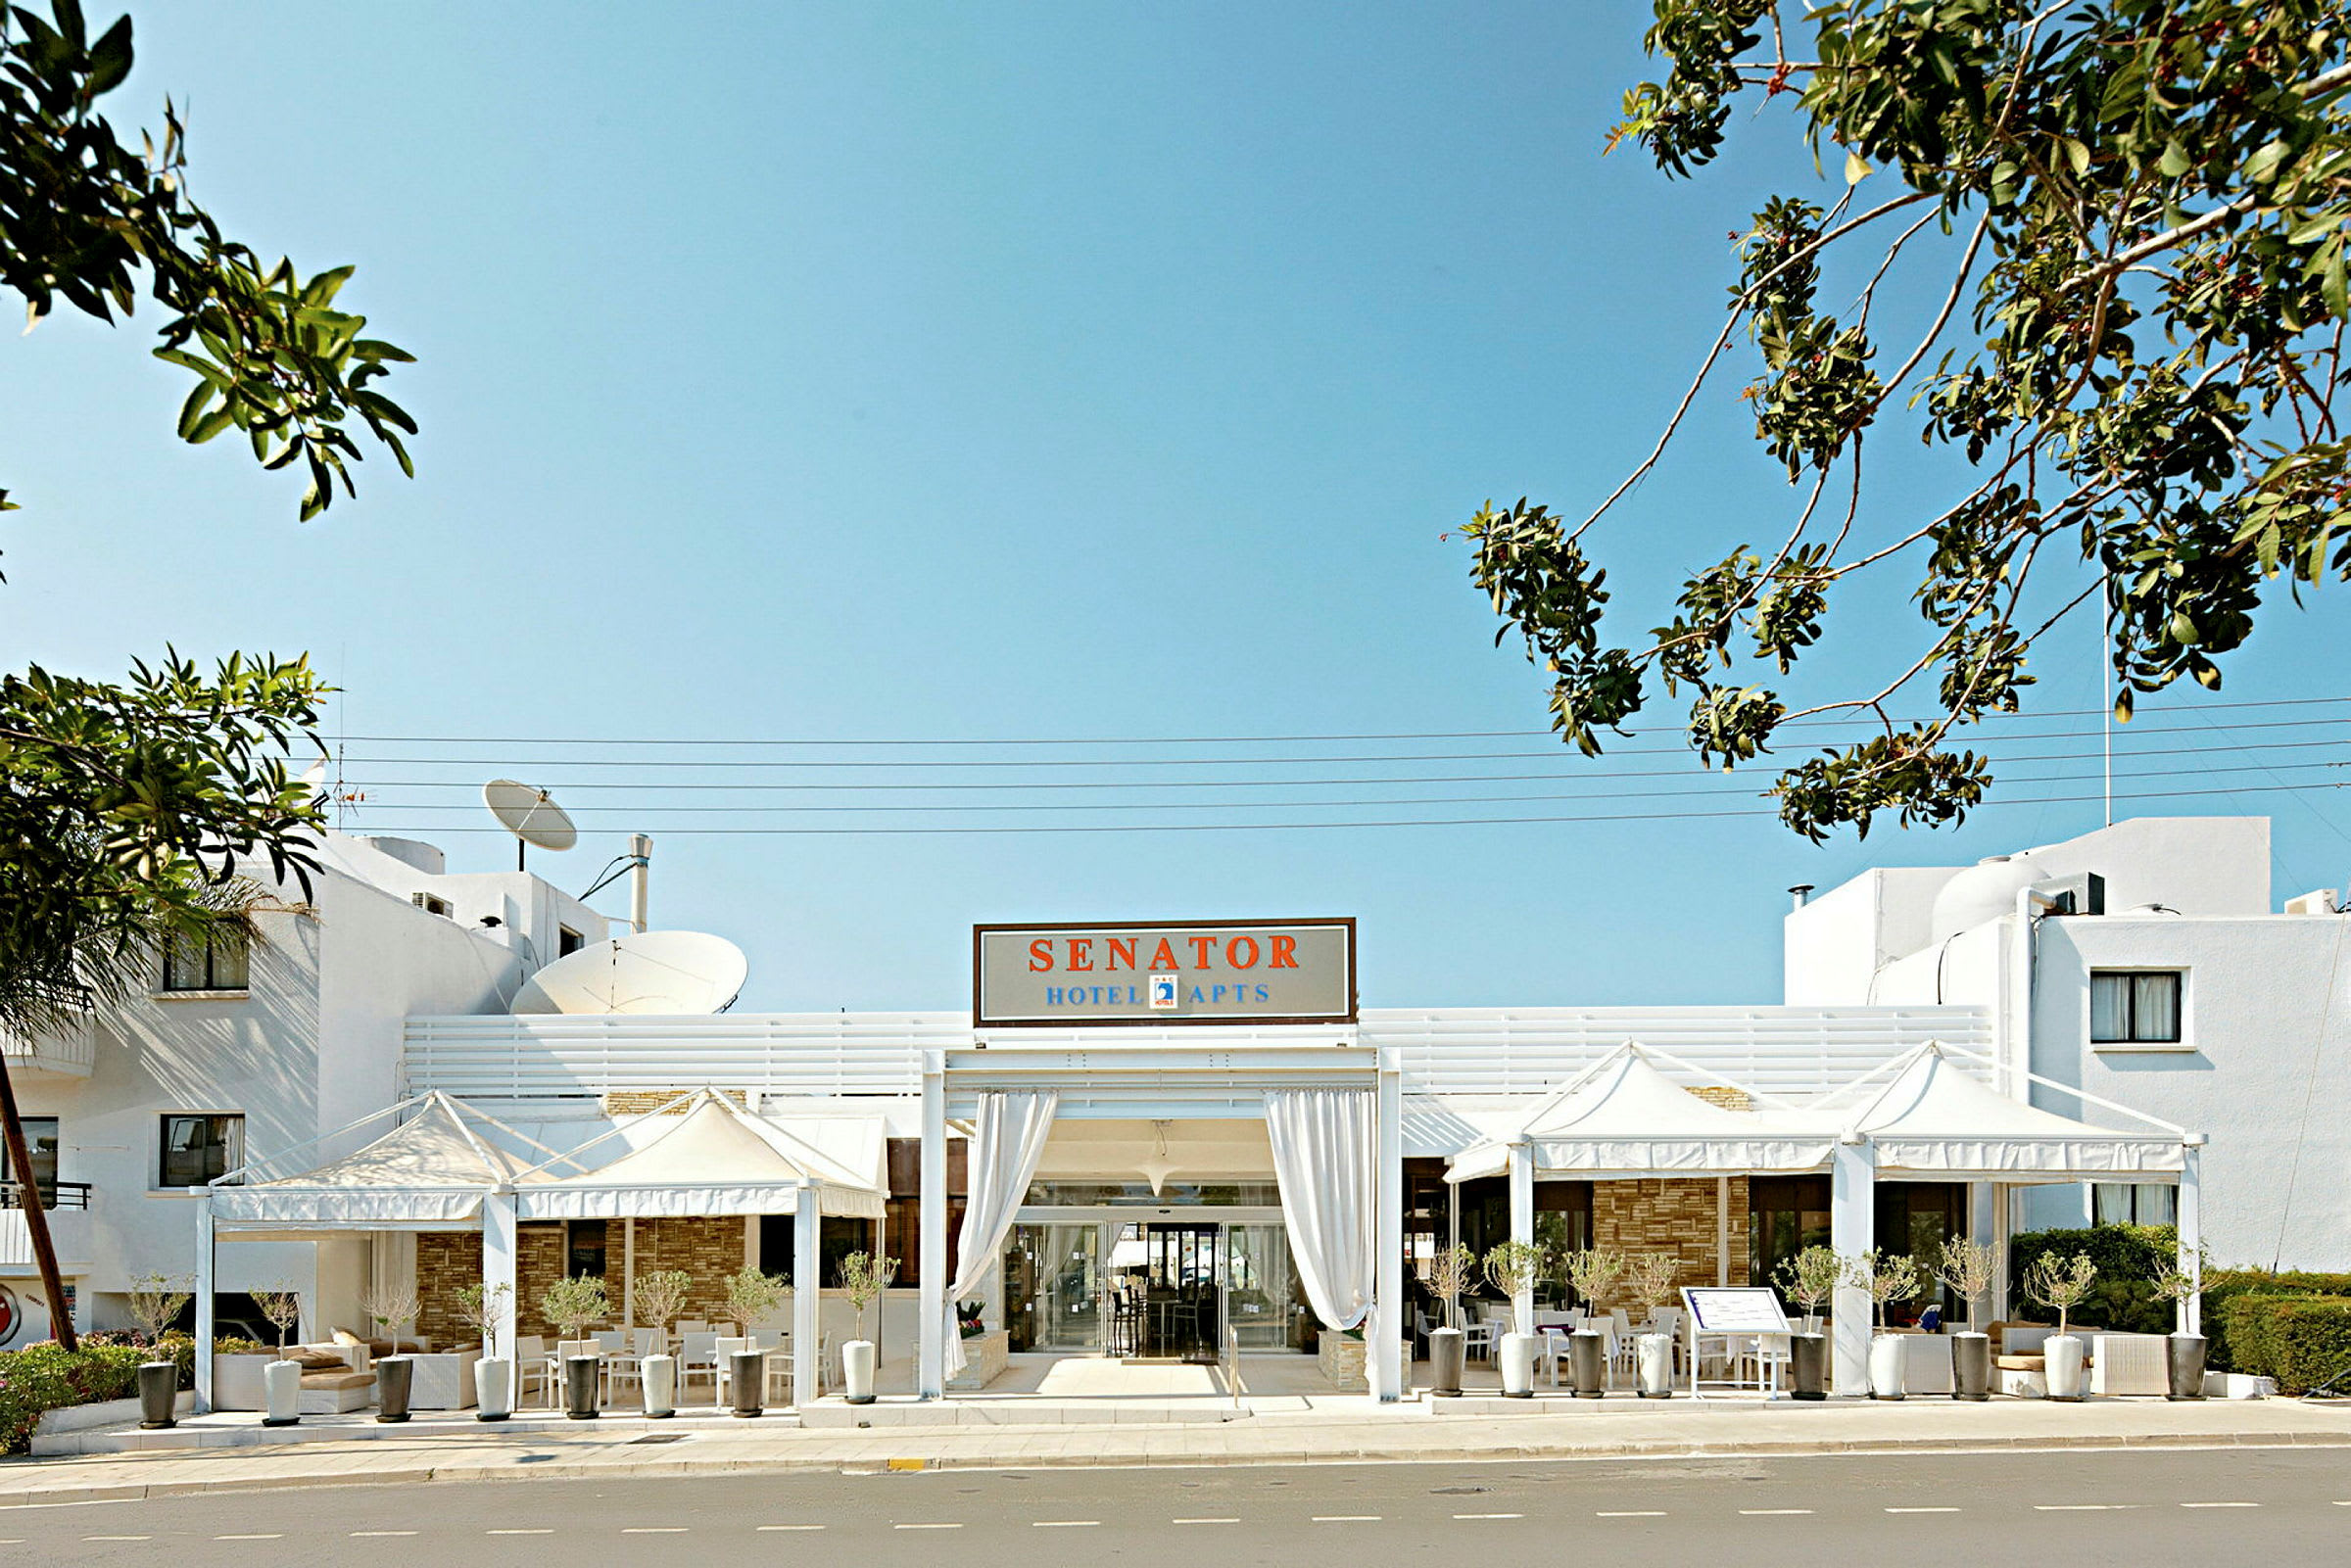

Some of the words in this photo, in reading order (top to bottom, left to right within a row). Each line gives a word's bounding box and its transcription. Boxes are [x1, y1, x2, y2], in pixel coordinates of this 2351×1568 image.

[1029, 935, 1299, 973] SENATOR
[1045, 984, 1144, 1006] HOTEL
[1188, 982, 1270, 1004] APTS
